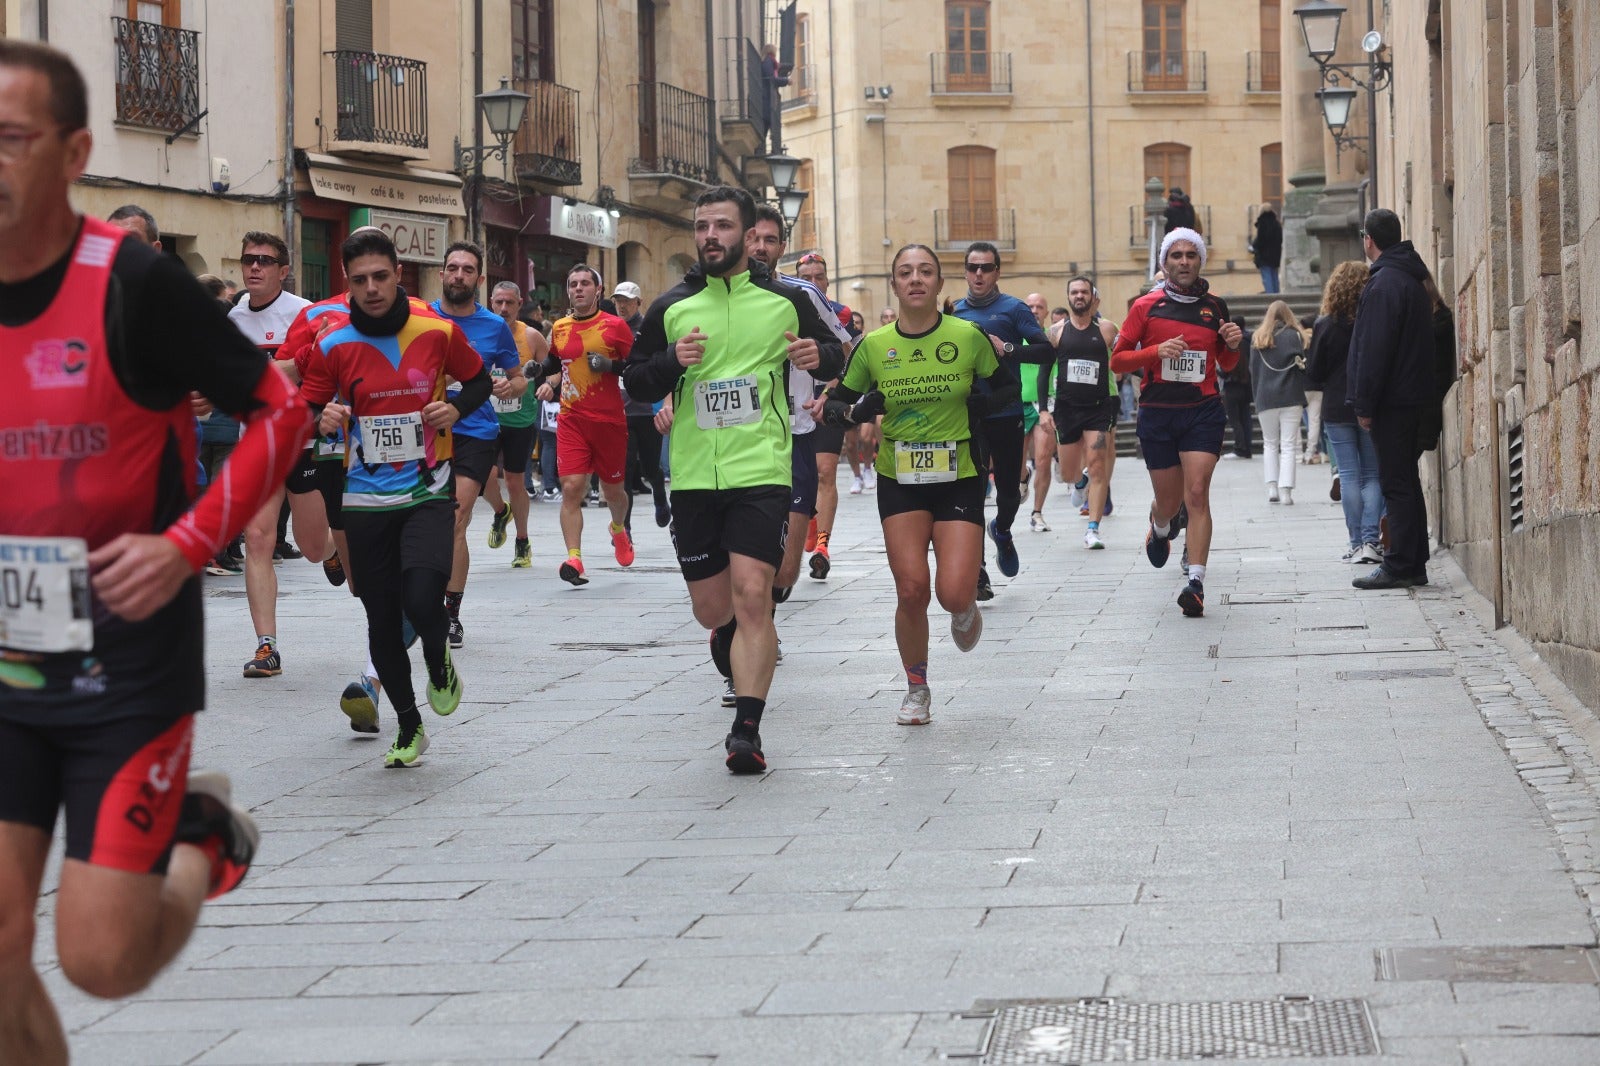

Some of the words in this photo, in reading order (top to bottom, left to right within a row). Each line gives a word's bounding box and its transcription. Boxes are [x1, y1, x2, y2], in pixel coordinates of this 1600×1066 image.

[314, 176, 332, 189] take
[334, 183, 356, 196] away
[370, 186, 386, 198] café
[388, 188, 394, 198] &
[1073, 365, 1091, 376] 1766
[1169, 358, 1194, 372] 1003
[709, 378, 751, 391] SETEL
[881, 373, 961, 388] CORRECAMINOS
[887, 384, 951, 398] CARBAJOSA
[705, 390, 741, 412] 1279
[896, 396, 942, 406] SALAMANCA
[374, 416, 416, 427] SETEL
[0, 420, 106, 459] erizos
[371, 427, 402, 447] 756
[911, 441, 950, 450] SETEL
[910, 451, 934, 469] 128
[0, 544, 70, 563] ETEL
[0, 568, 43, 611] 04
